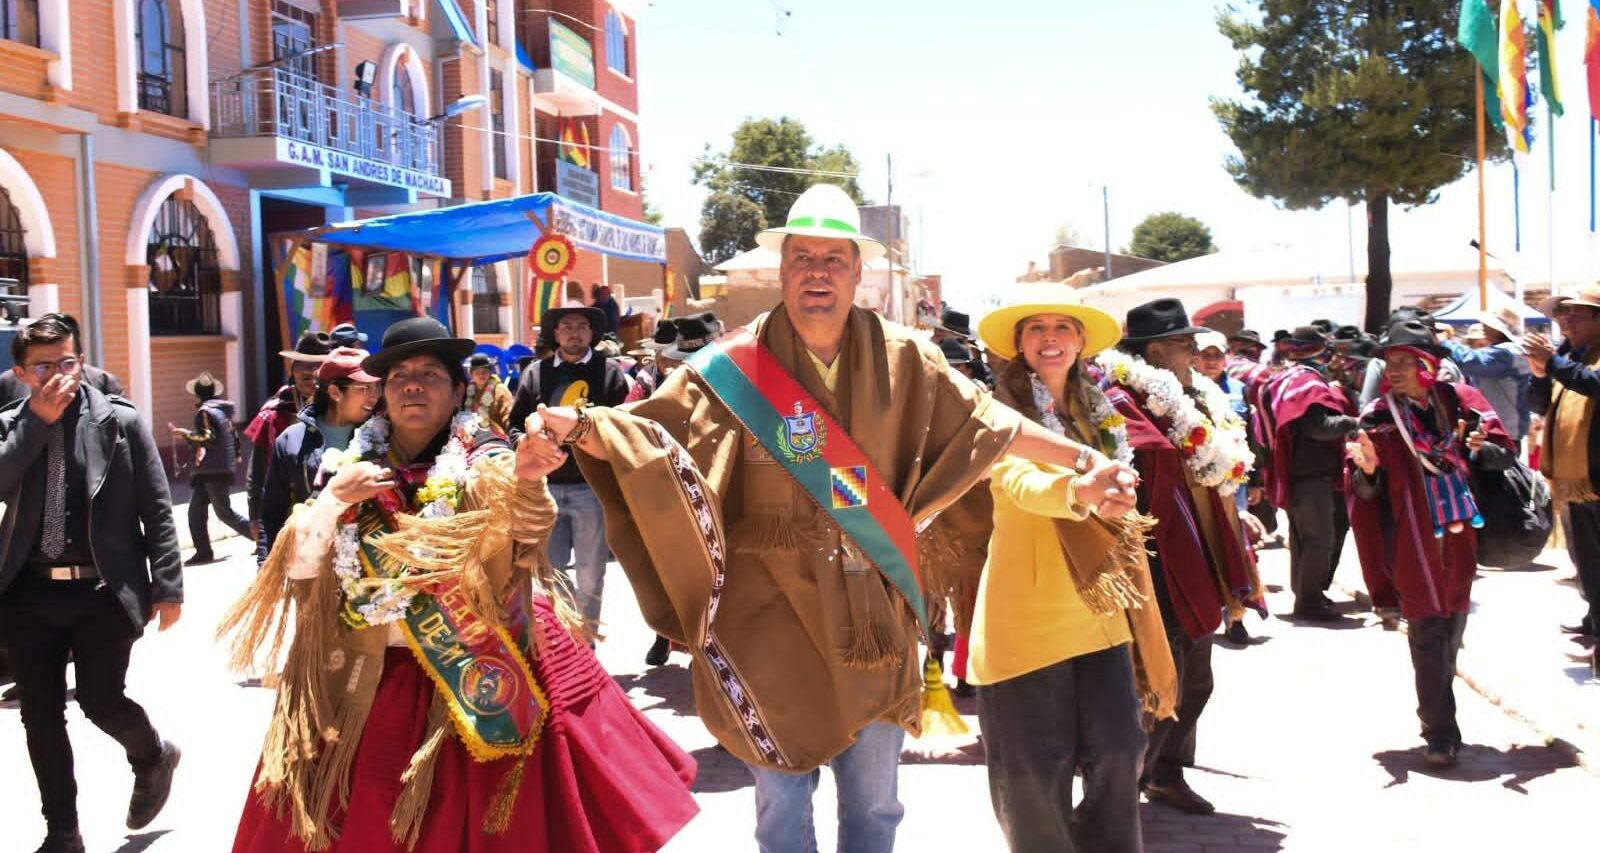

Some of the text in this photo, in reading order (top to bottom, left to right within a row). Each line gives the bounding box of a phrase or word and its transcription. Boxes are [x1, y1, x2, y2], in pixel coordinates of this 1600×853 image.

[328, 152, 349, 172] SAN
[352, 158, 389, 181] ANDRES
[391, 168, 403, 184] DE
[405, 172, 445, 193] MACHACA
[418, 612, 452, 649] DE
